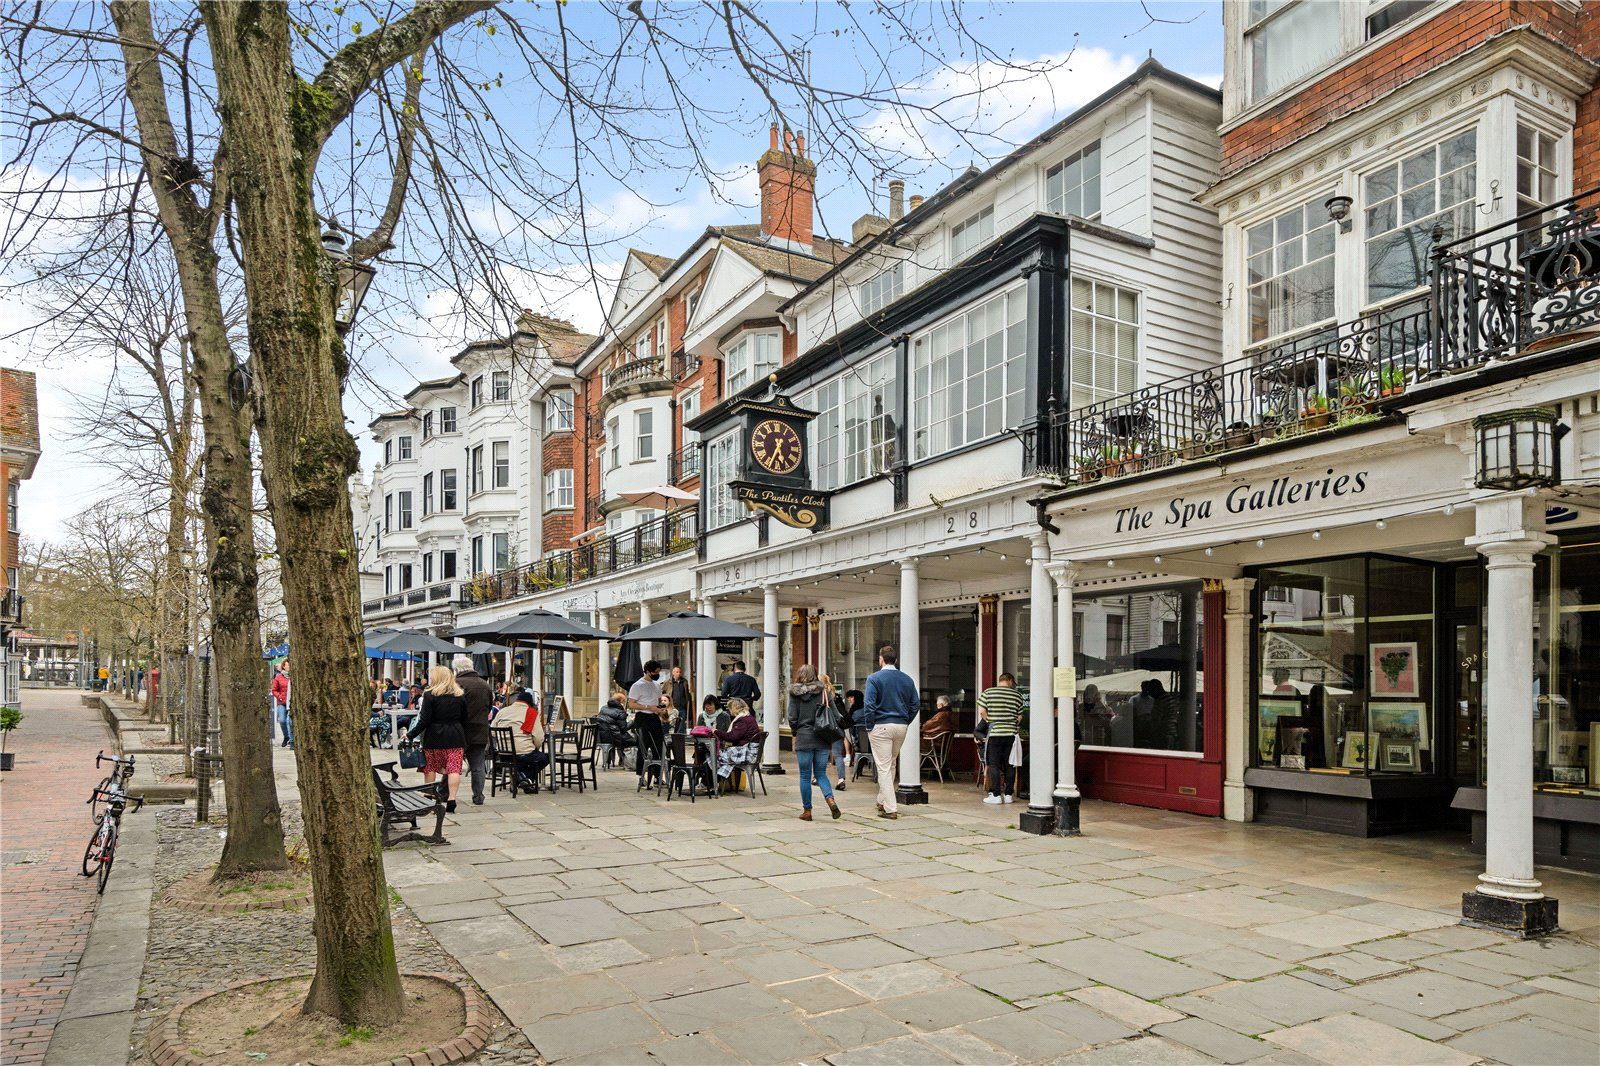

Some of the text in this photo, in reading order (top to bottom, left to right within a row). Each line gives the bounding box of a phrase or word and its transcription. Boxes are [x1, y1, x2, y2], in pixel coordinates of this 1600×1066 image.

[739, 488, 825, 507] The Pantiles Clock
[1114, 468, 1369, 534] The Spa Galleries
